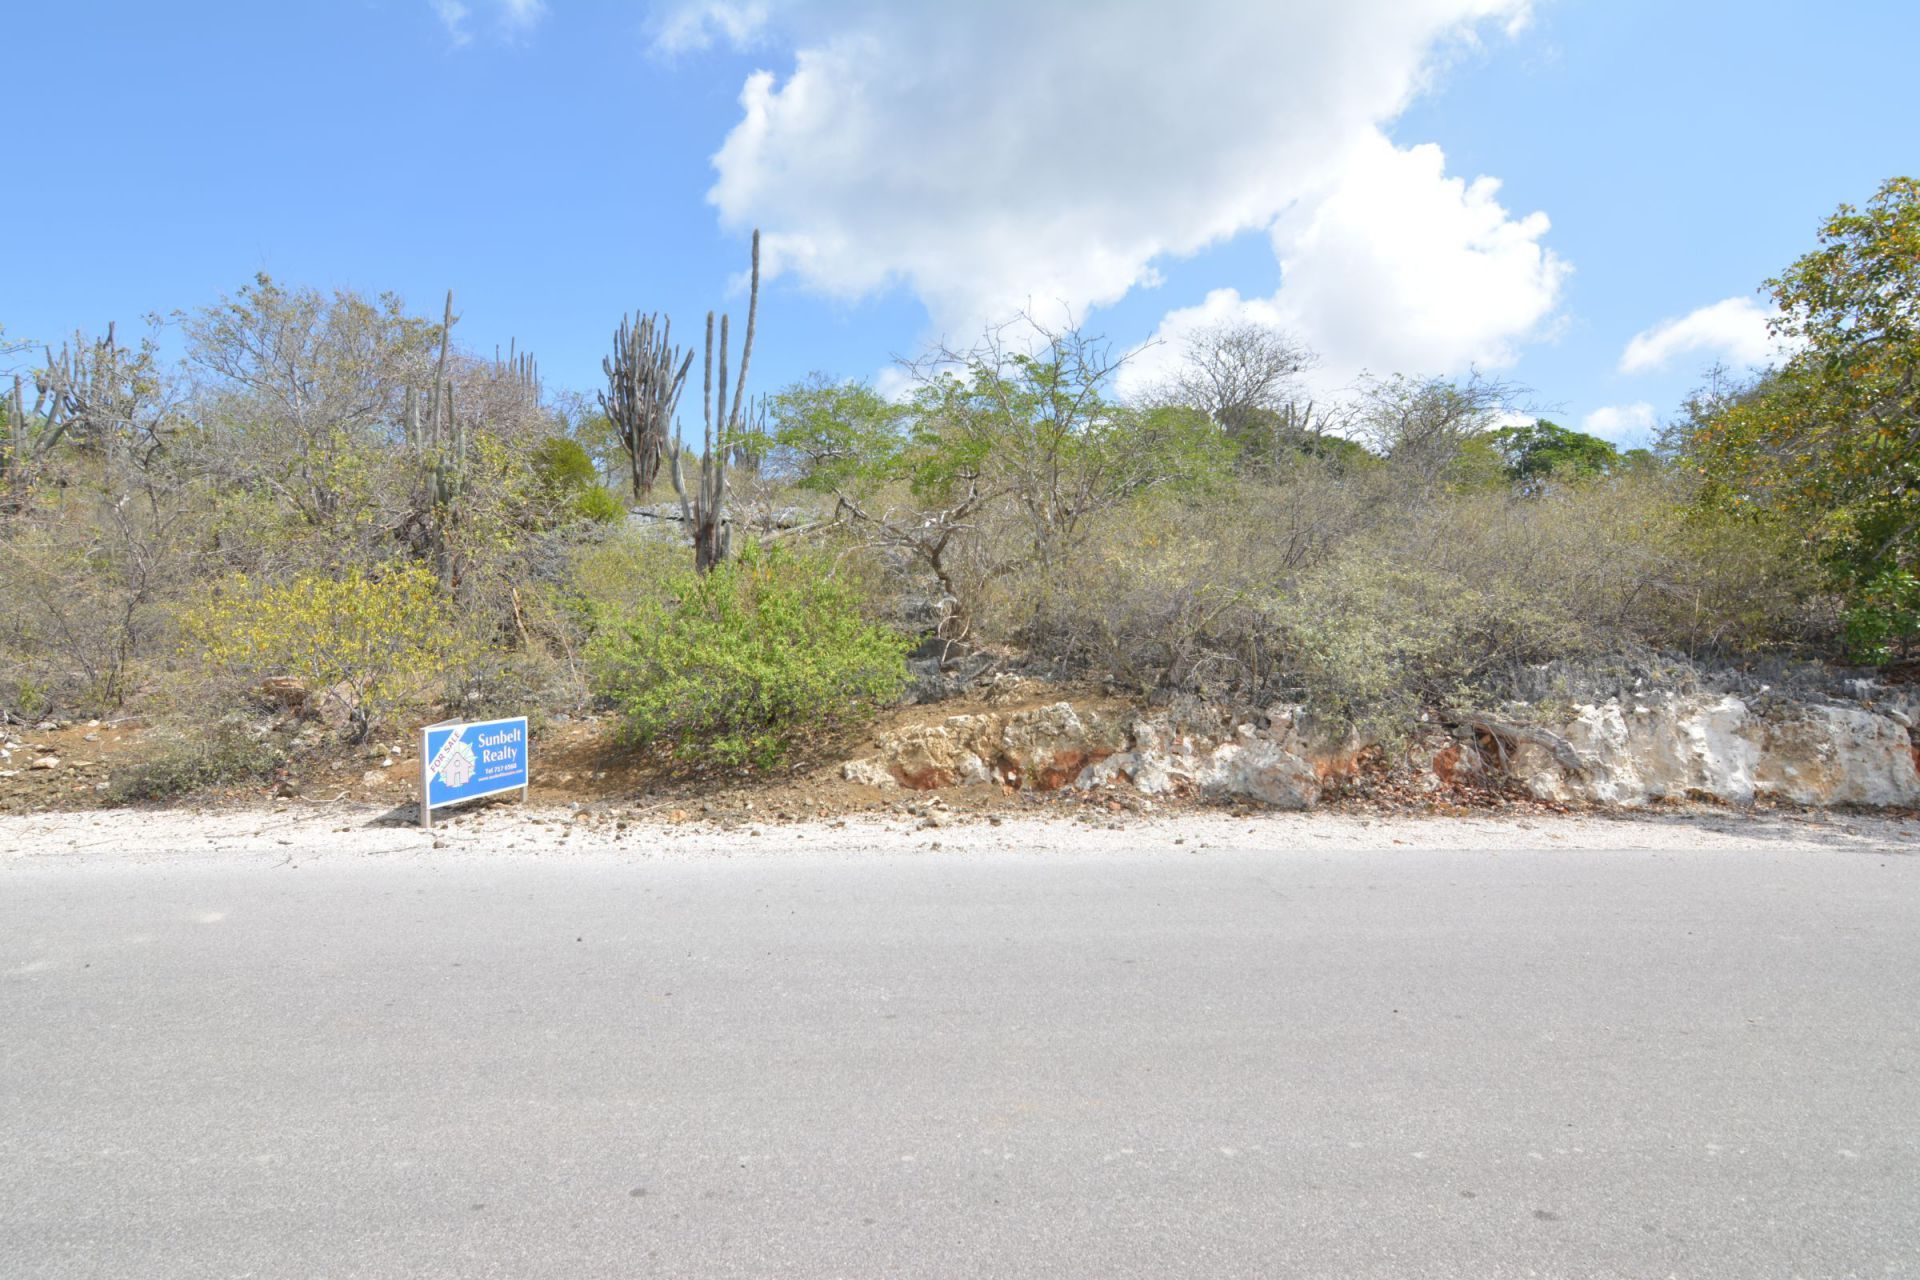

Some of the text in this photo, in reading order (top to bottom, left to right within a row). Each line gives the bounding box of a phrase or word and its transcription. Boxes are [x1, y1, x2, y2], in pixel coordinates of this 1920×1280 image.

[478, 728, 521, 748] Sunbelt
[430, 732, 460, 772] FOR SALE
[483, 745, 517, 763] Realty
